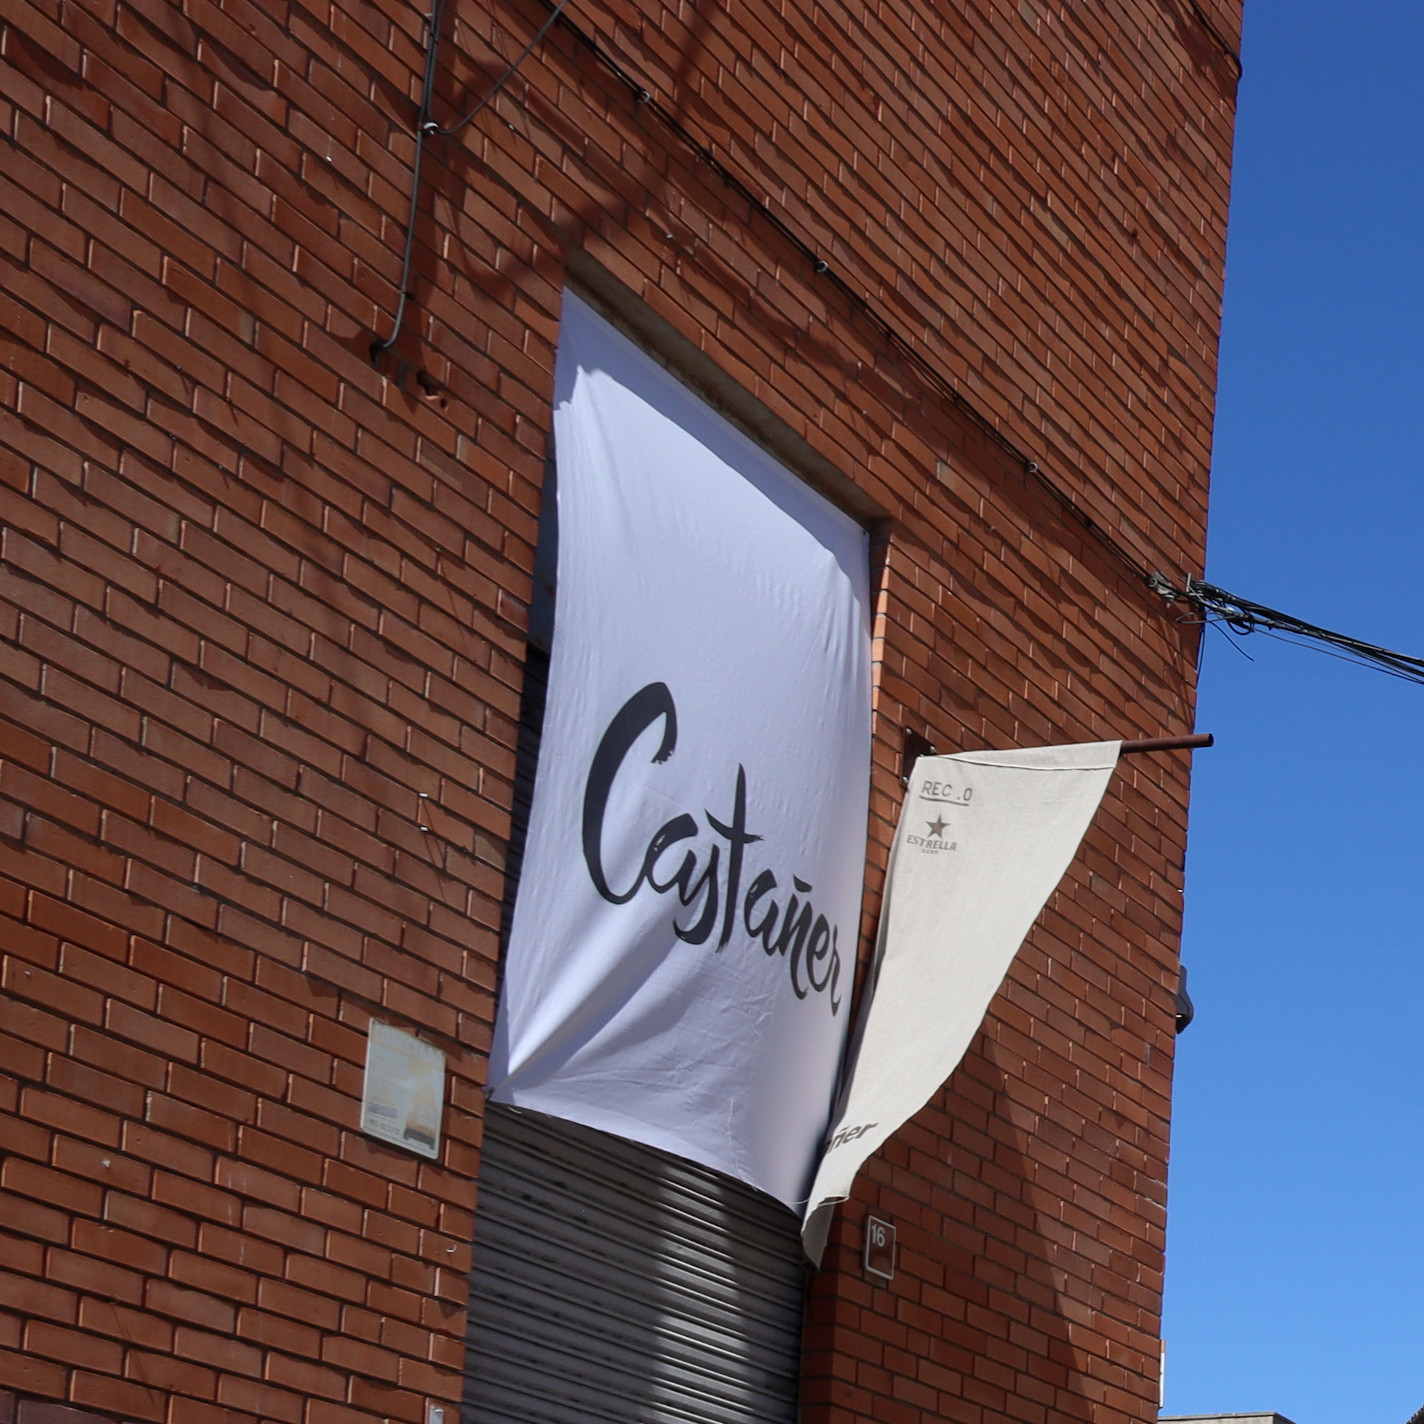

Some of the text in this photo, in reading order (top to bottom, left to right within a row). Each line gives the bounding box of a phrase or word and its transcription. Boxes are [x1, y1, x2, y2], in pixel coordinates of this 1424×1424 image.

[921, 781, 952, 797] REC
[582, 681, 841, 1016] Castañer
[906, 835, 957, 851] ESTRELLA
[871, 1224, 886, 1247] 16
